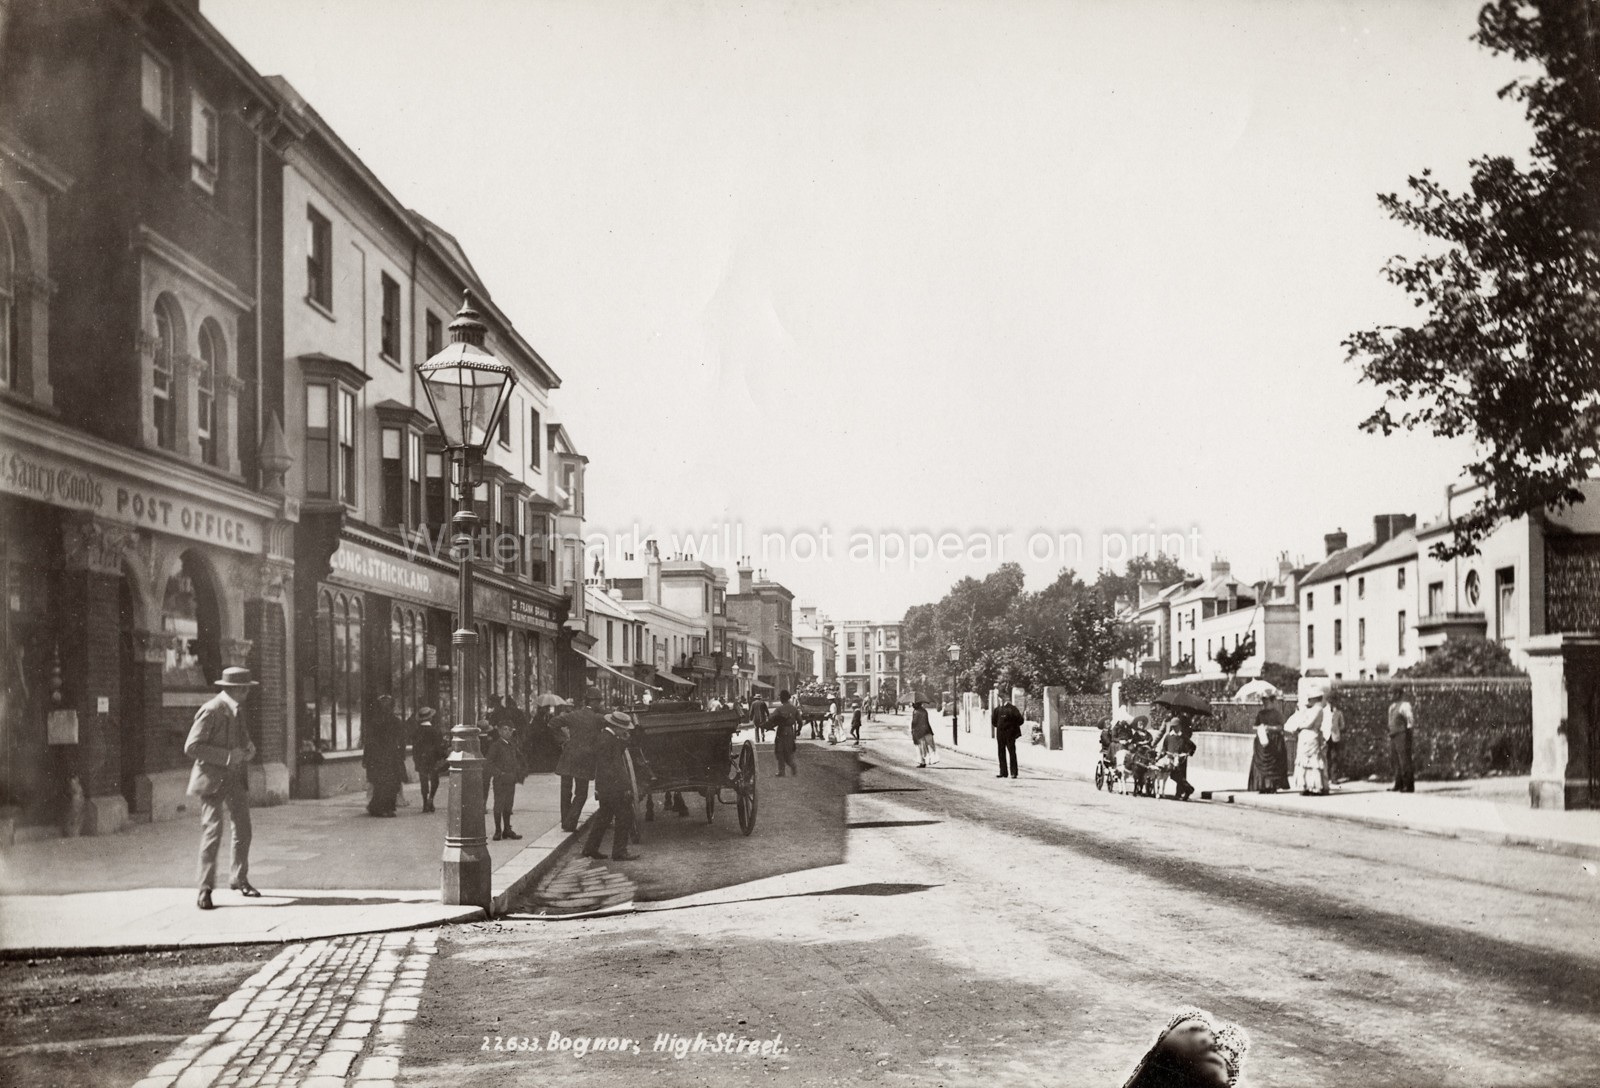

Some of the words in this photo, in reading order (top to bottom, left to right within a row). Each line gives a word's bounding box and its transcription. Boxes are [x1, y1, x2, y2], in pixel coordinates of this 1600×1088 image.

[57, 467, 103, 509] Goods
[116, 487, 172, 526] POST
[181, 507, 251, 548] OFFICE.
